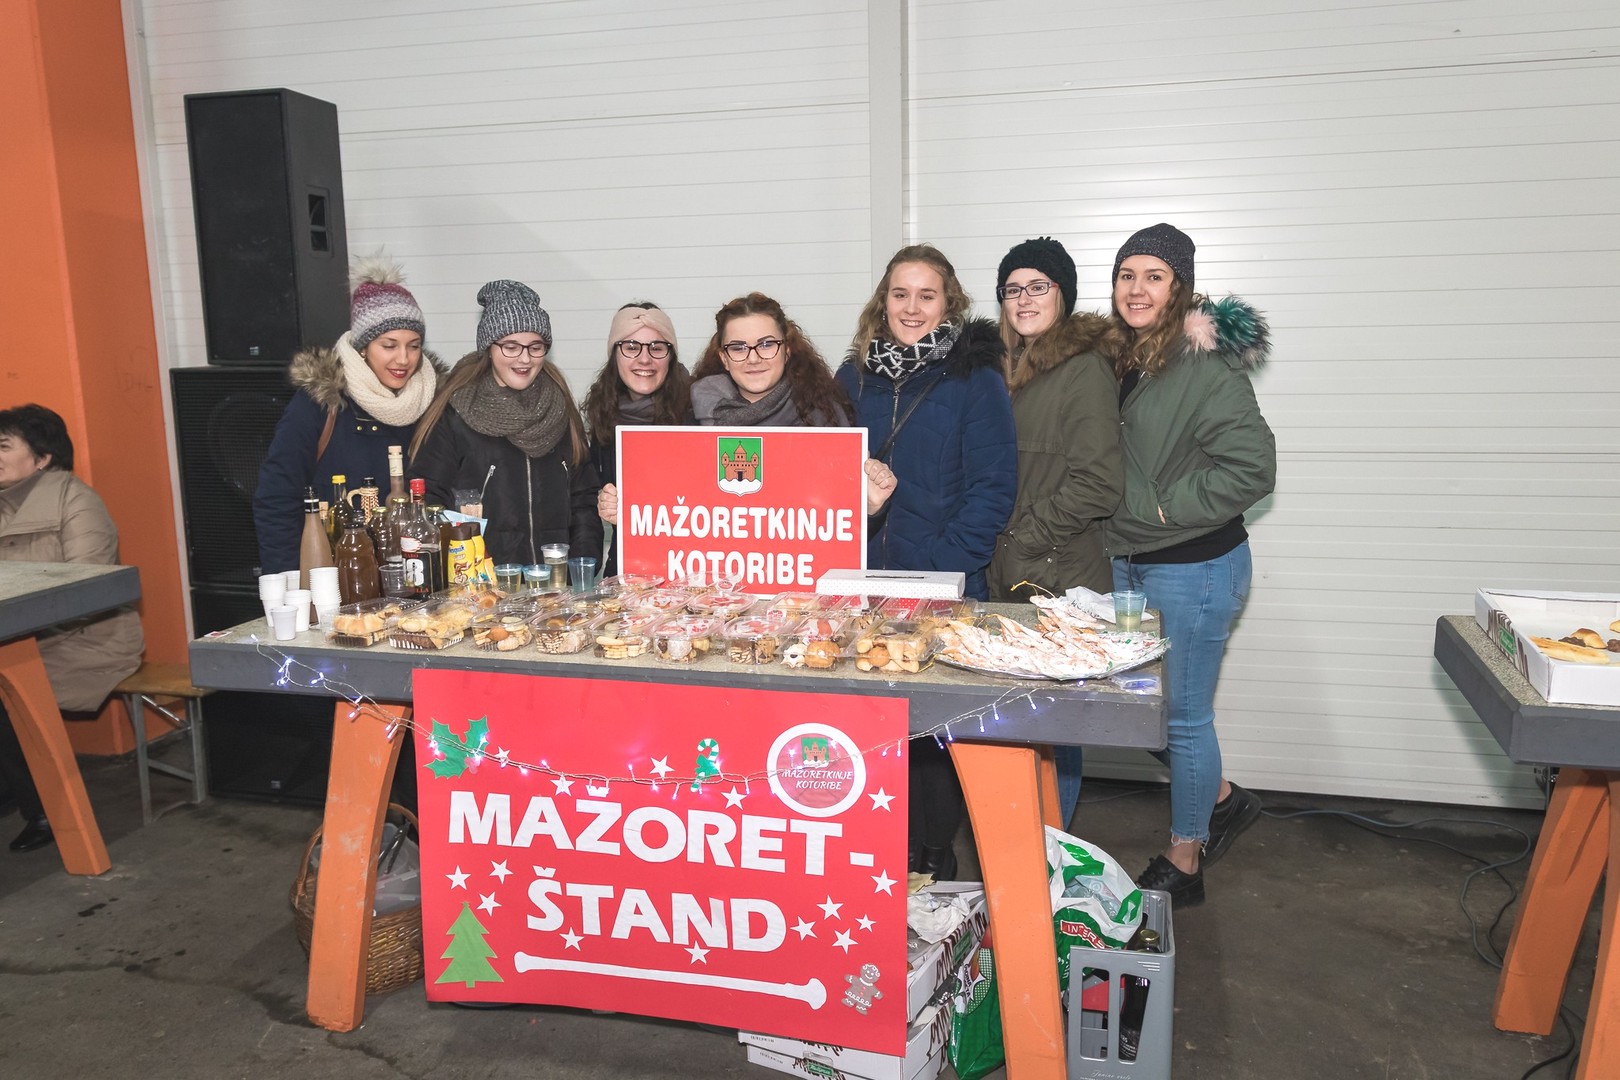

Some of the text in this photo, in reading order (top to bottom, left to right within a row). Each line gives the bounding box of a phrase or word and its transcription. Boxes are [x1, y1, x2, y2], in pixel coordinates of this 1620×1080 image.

[630, 495, 854, 542] MAŽORETKINJE
[667, 549, 815, 586] KOTORIBE
[795, 780, 842, 790] KOTORIBE
[448, 785, 875, 876] MAŽORET-
[527, 865, 787, 953] ŠTAND
